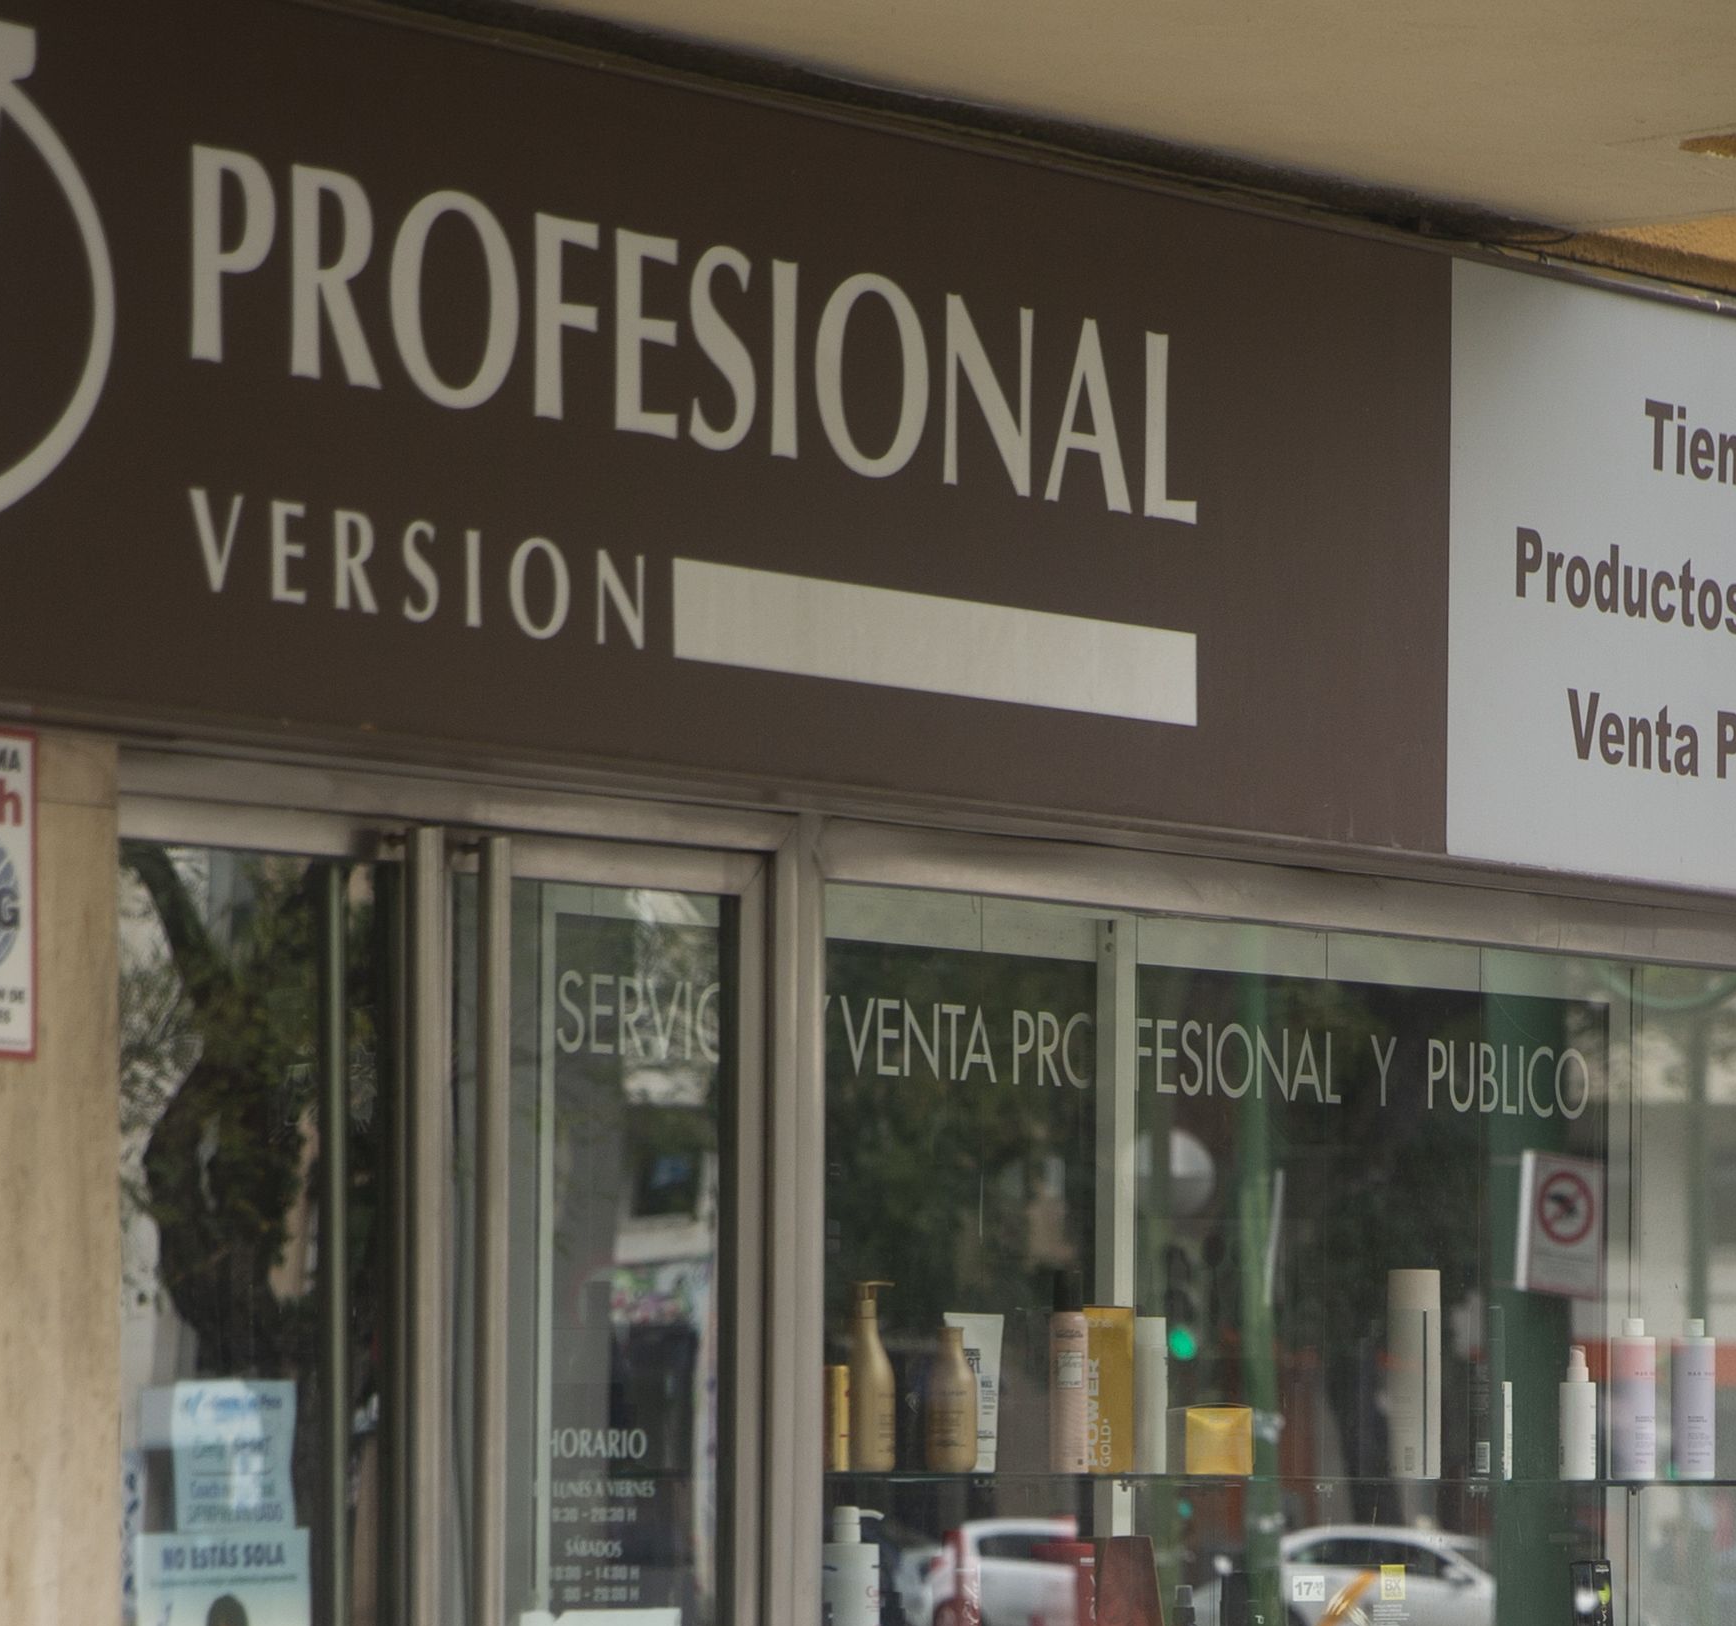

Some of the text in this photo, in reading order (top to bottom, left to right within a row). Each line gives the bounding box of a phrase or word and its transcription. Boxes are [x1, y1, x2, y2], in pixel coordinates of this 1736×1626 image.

[190, 143, 1197, 524] PROFESIONAL
[190, 487, 646, 650] VERSION
[1567, 688, 1698, 777] Venta
[840, 995, 997, 1083] VENTA
[1369, 1034, 1398, 1107] Y
[1428, 1038, 1590, 1120] PUBLICO
[549, 1427, 647, 1459] HORARIO
[606, 1479, 656, 1498] VIERNES
[162, 1543, 285, 1570] NO ESTÁS SOLA
